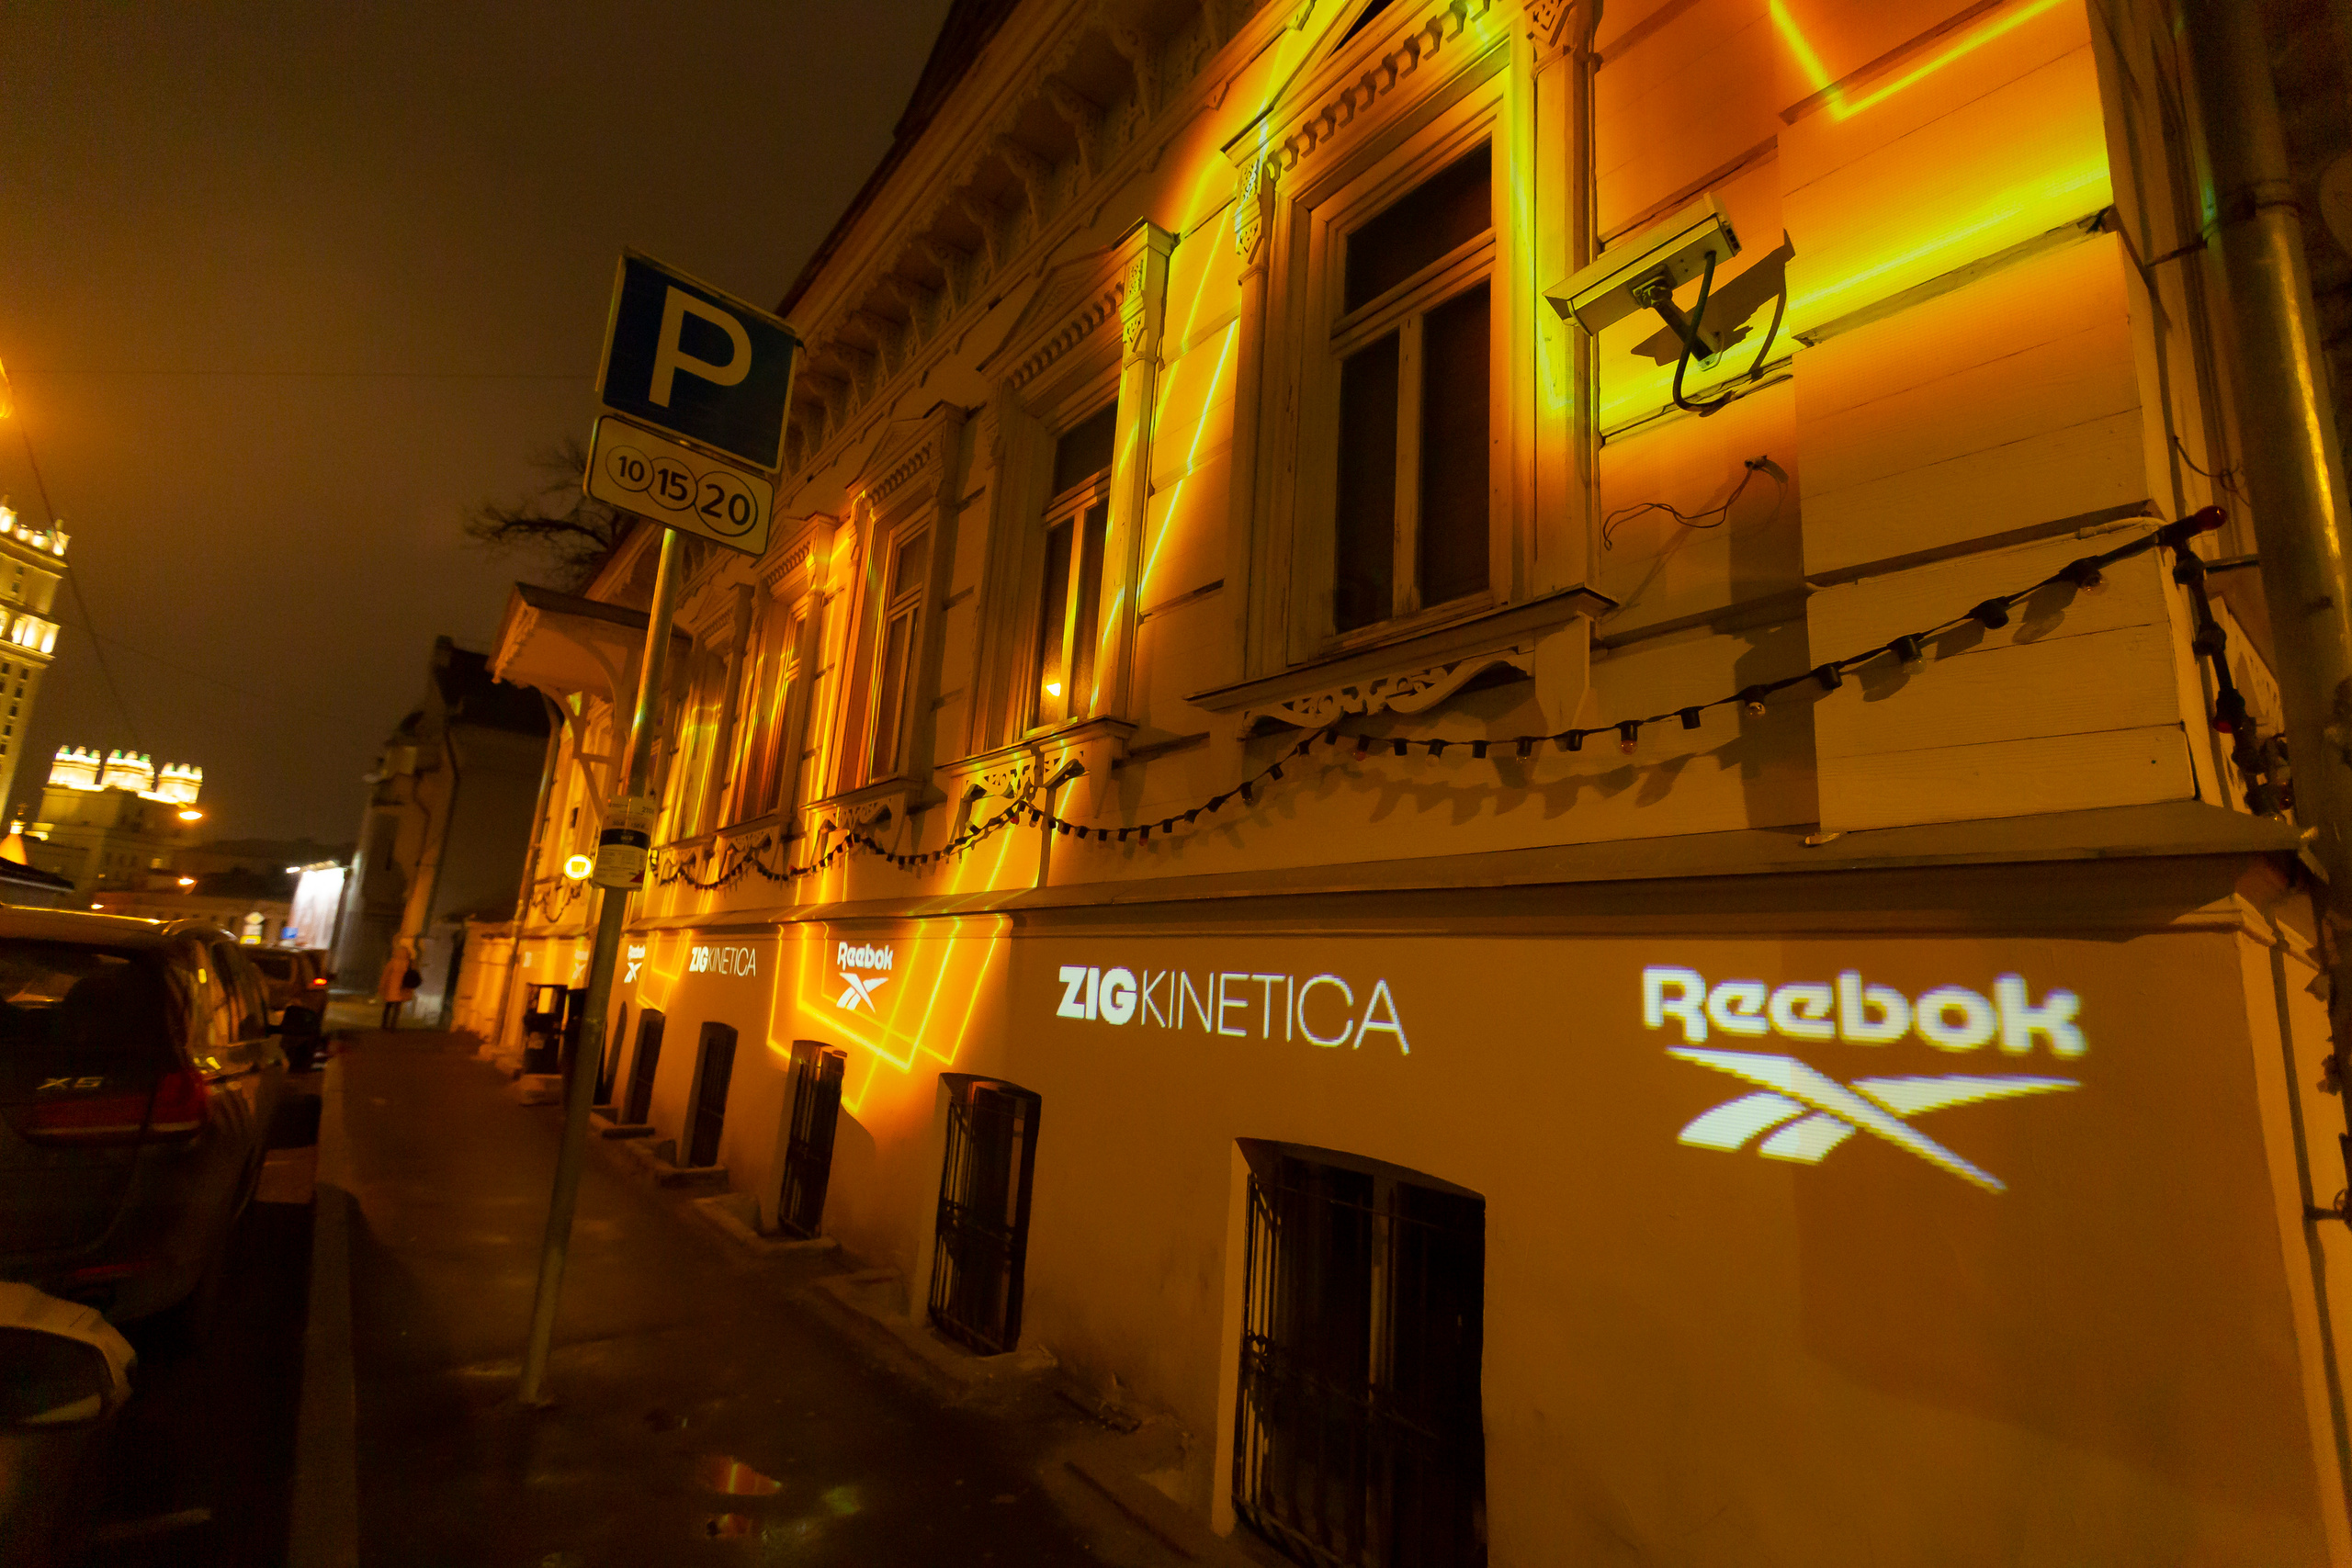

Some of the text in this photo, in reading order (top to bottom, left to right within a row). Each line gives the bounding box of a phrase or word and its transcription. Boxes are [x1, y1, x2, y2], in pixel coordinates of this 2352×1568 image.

[649, 285, 752, 408] P
[617, 455, 751, 526] 10 15 20
[837, 941, 894, 971] Reebok
[1642, 964, 2088, 1059] Reebok
